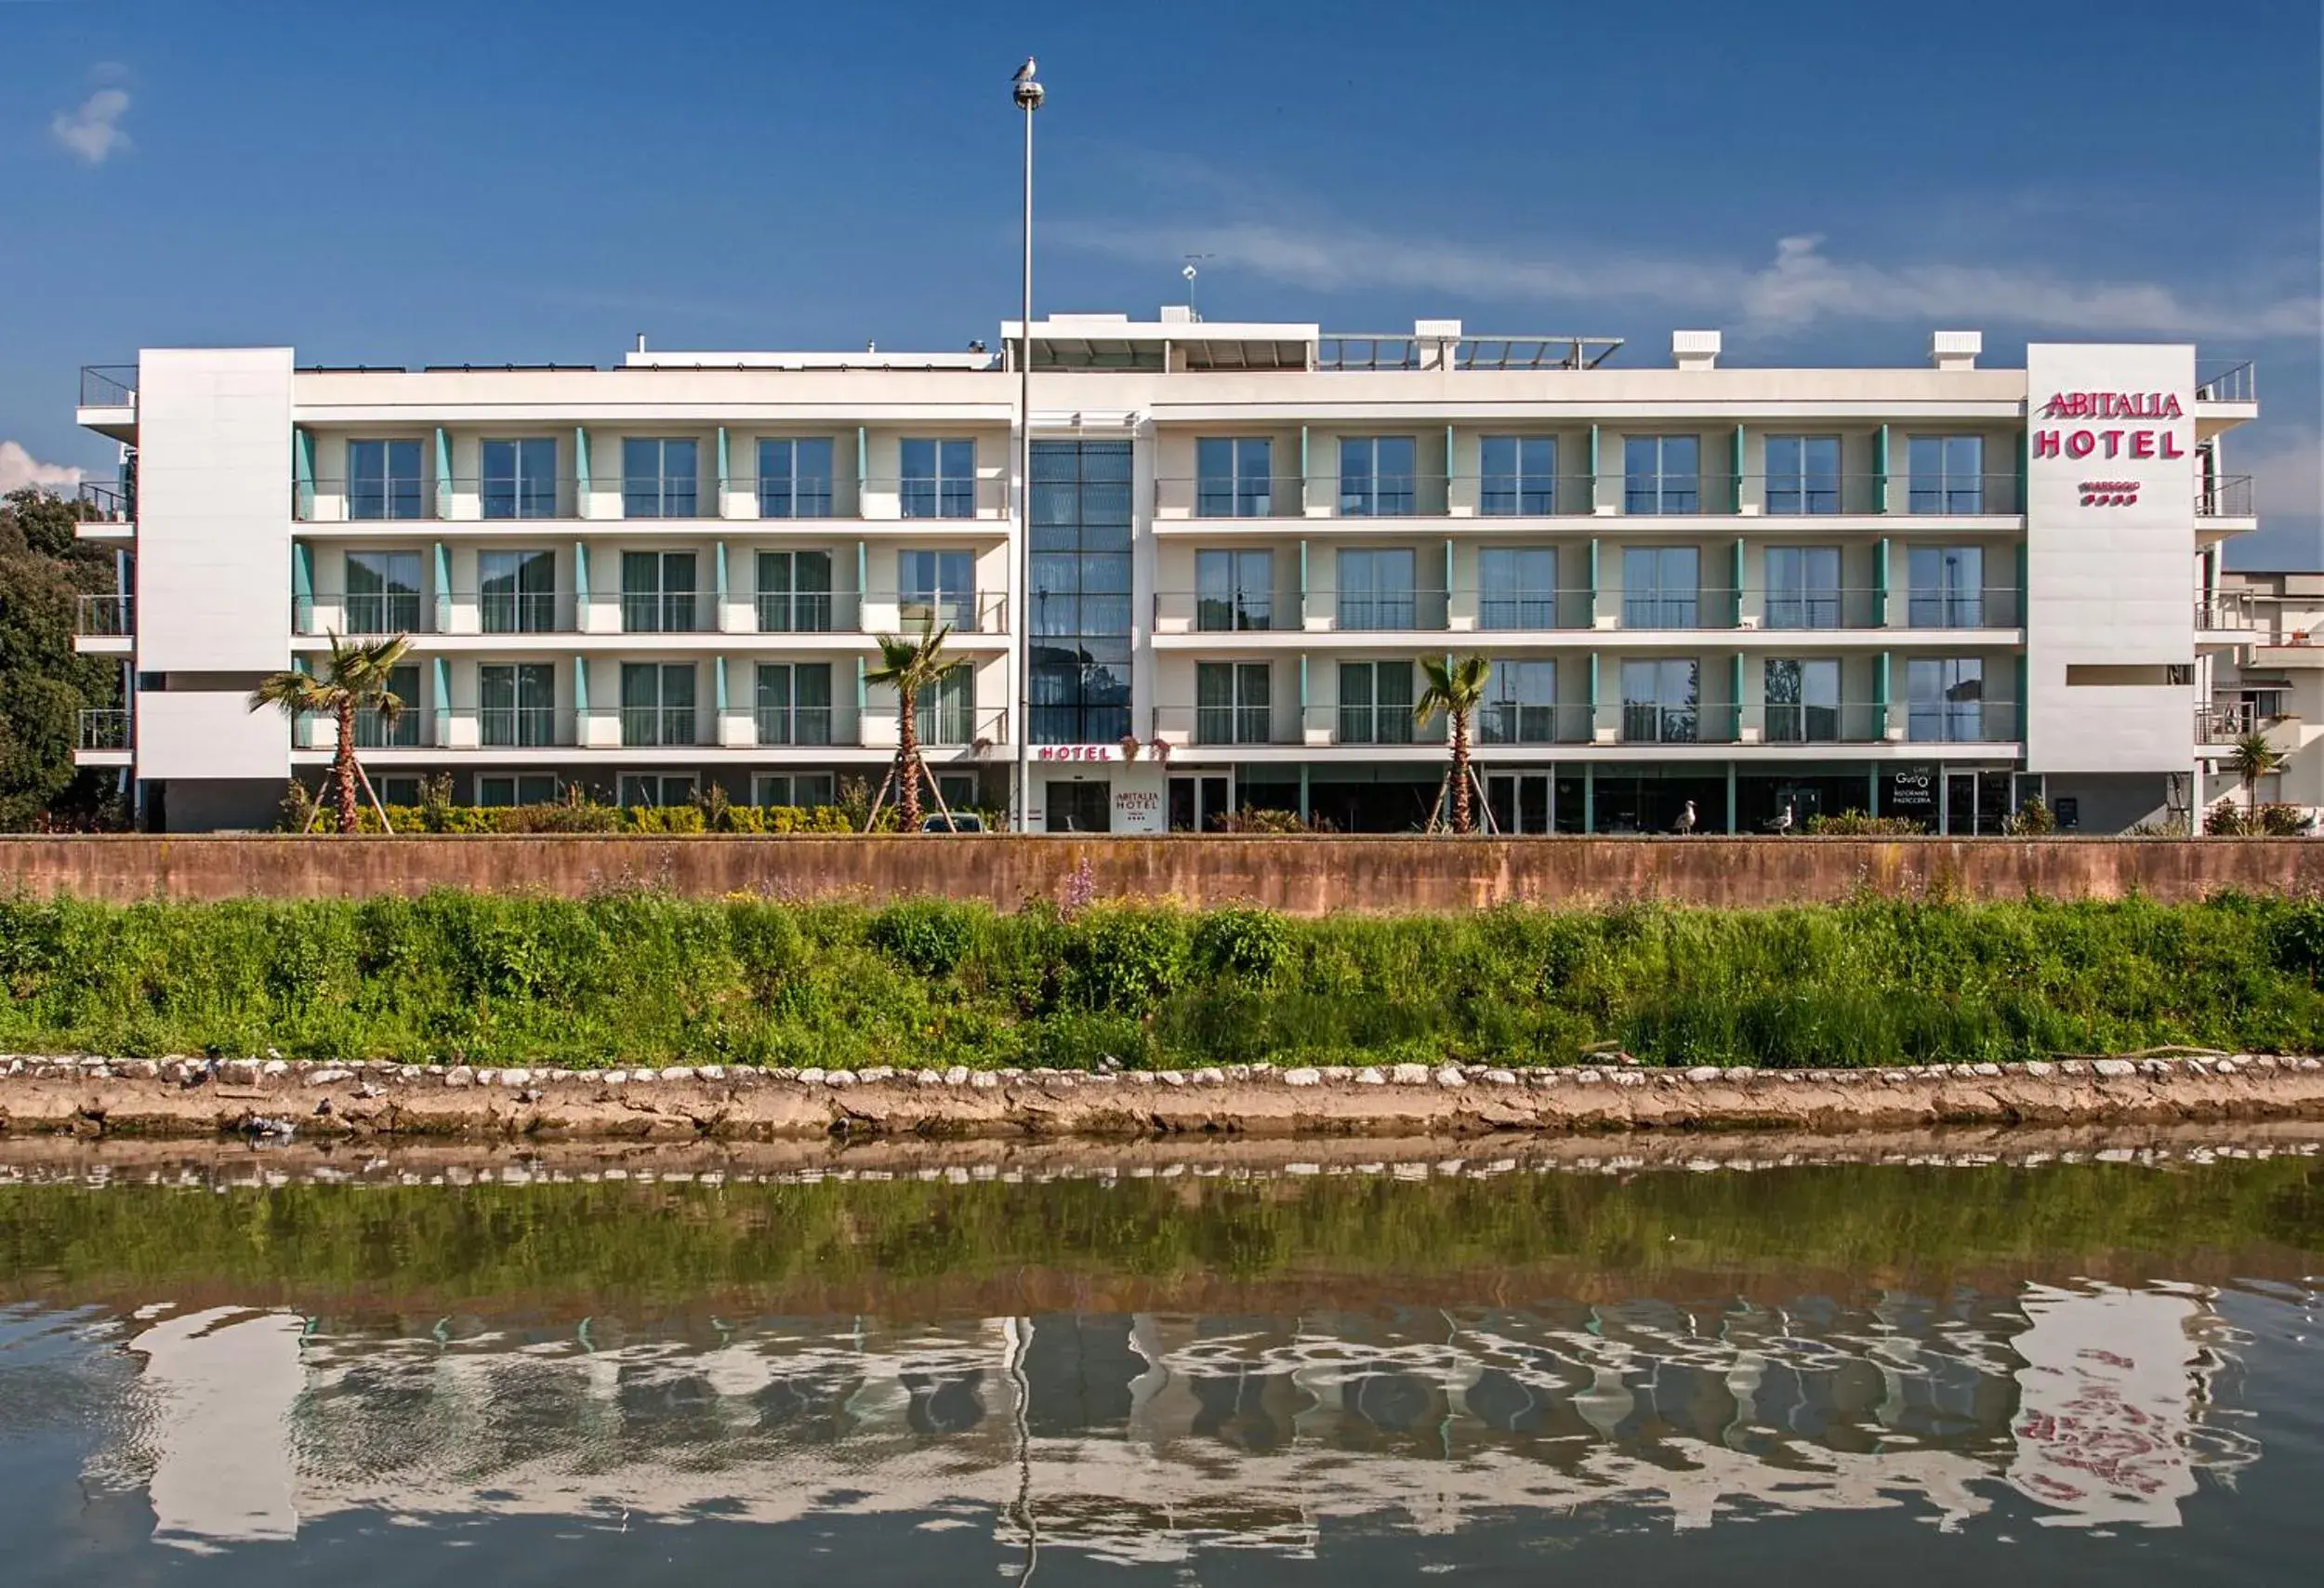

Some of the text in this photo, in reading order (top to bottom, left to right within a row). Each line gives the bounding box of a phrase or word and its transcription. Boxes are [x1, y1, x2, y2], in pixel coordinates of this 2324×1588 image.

[2035, 391, 2185, 419] ABITALIA
[2033, 430, 2185, 459] HOTEL
[1038, 747, 1112, 761] HOTEL
[1116, 792, 1158, 801] ABITALIA
[1116, 801, 1158, 810] HOTEL
